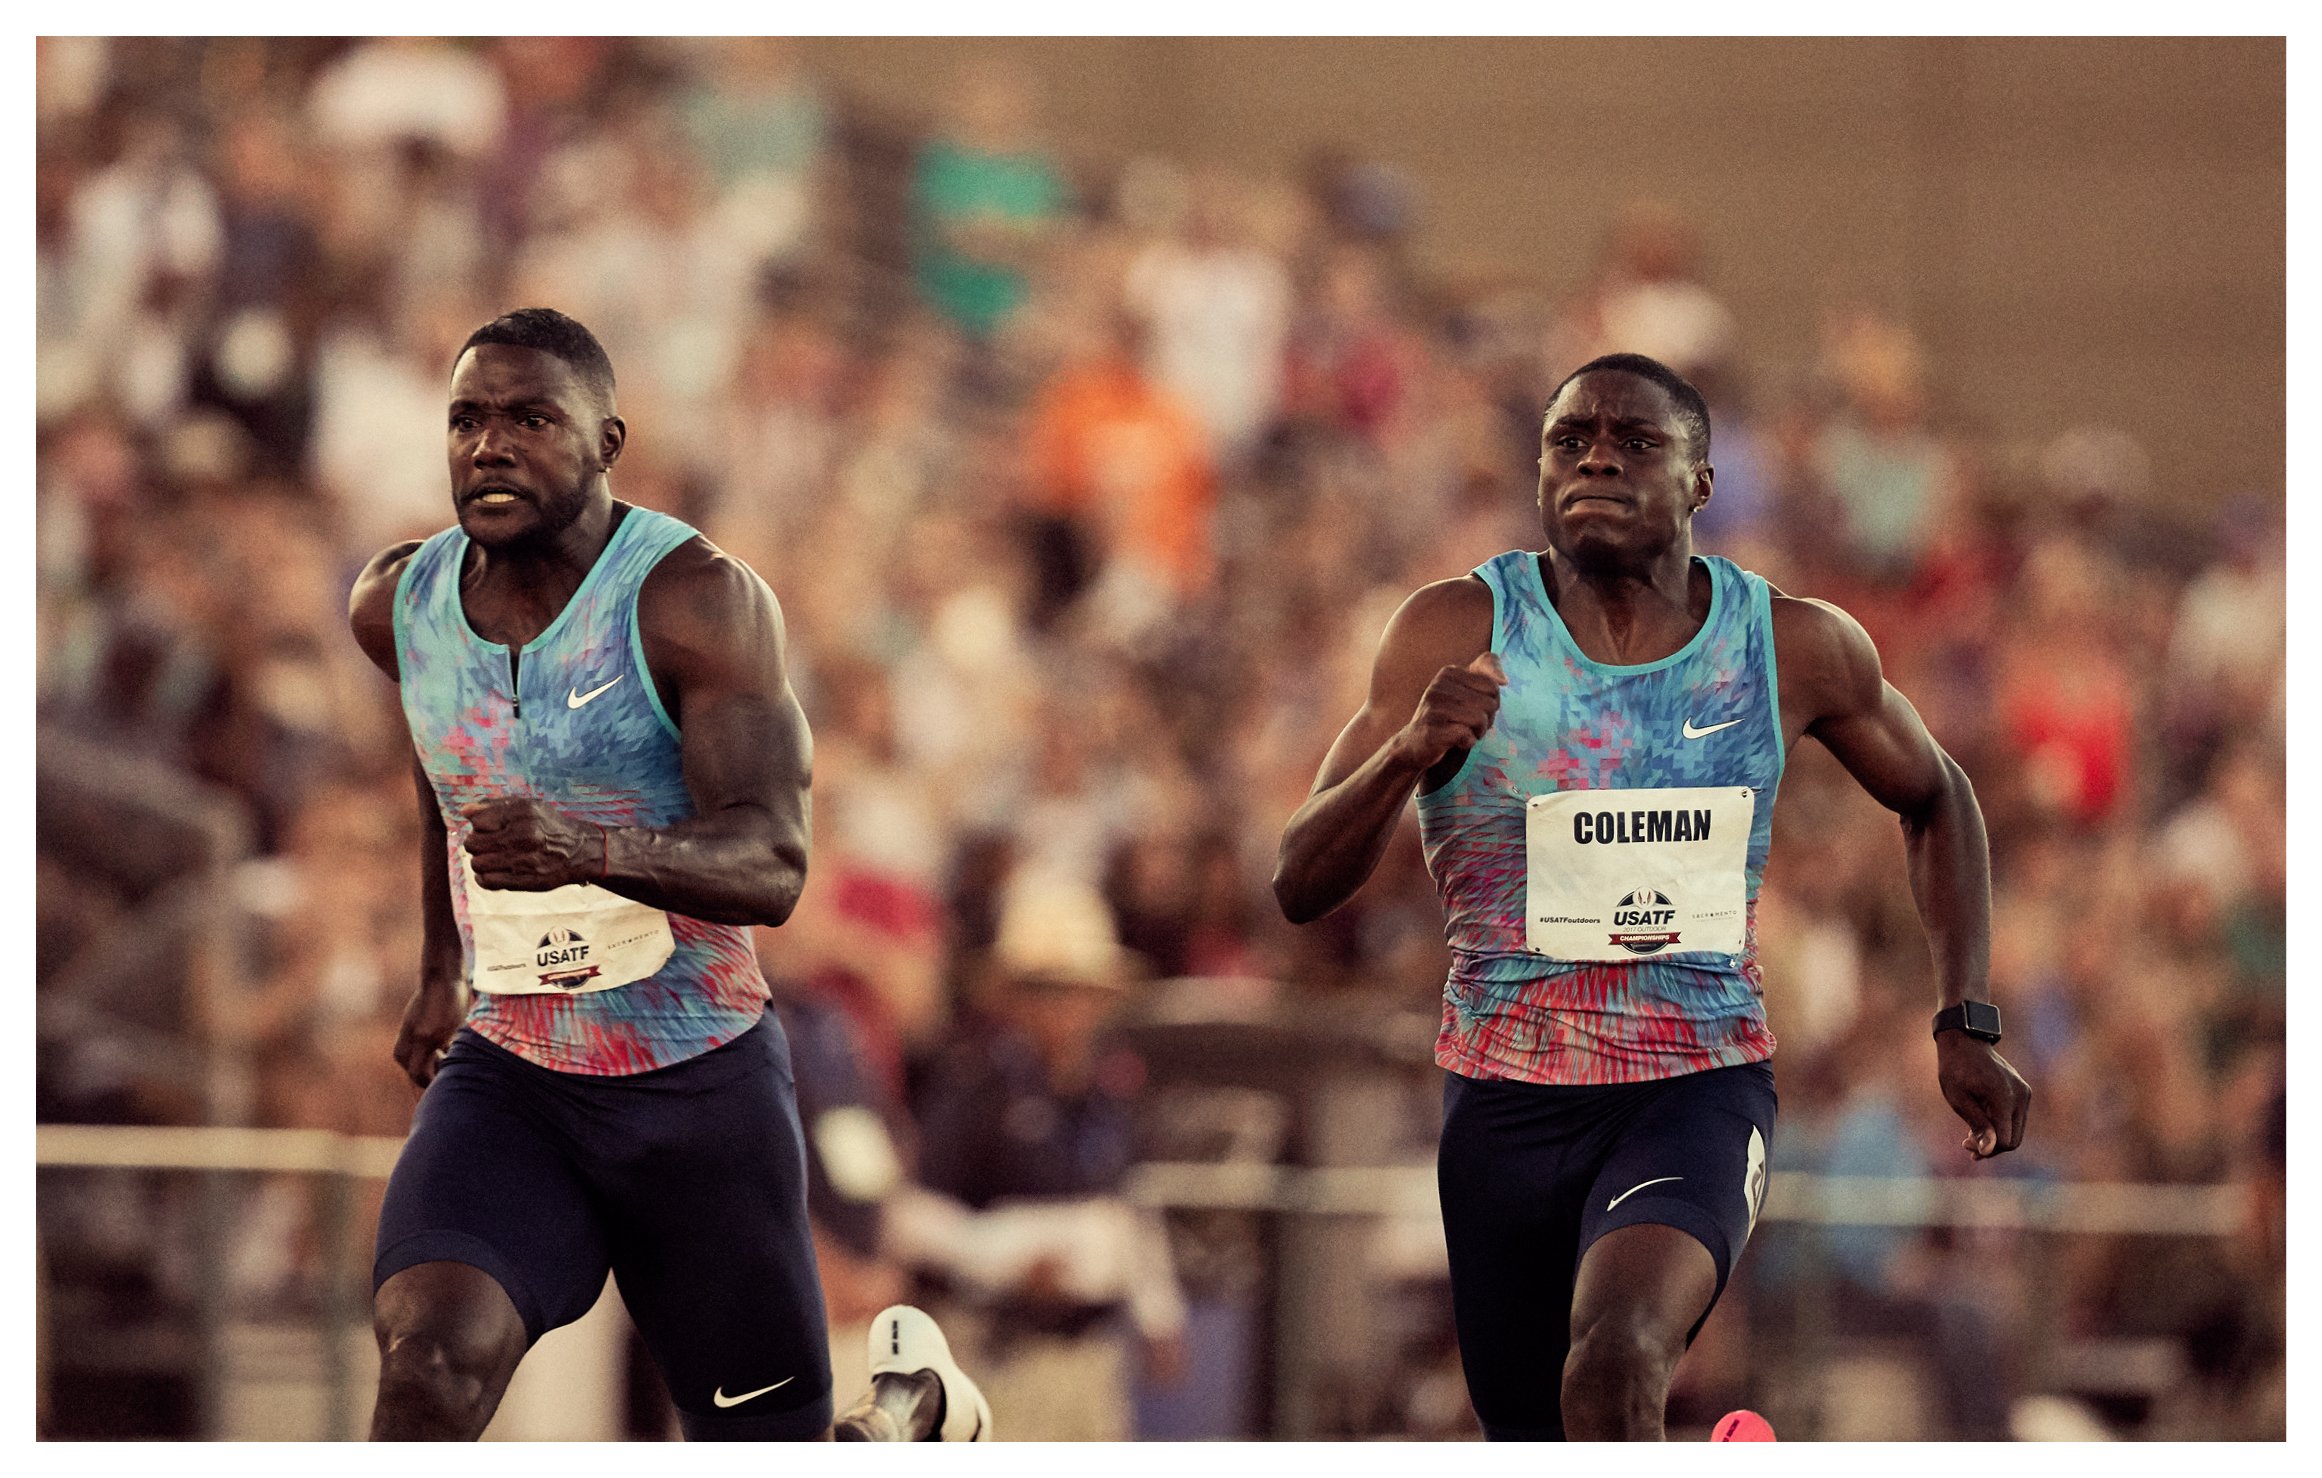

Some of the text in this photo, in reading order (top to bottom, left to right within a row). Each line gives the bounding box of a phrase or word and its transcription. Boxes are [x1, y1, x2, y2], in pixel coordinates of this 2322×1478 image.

[1574, 809, 1711, 845] COLEMAN
[1540, 916, 1600, 924] #USATFoutdoors
[1613, 910, 1676, 925] USATF
[1619, 934, 1670, 942] CHAMPIONSHIPS
[536, 945, 590, 967] USATF
